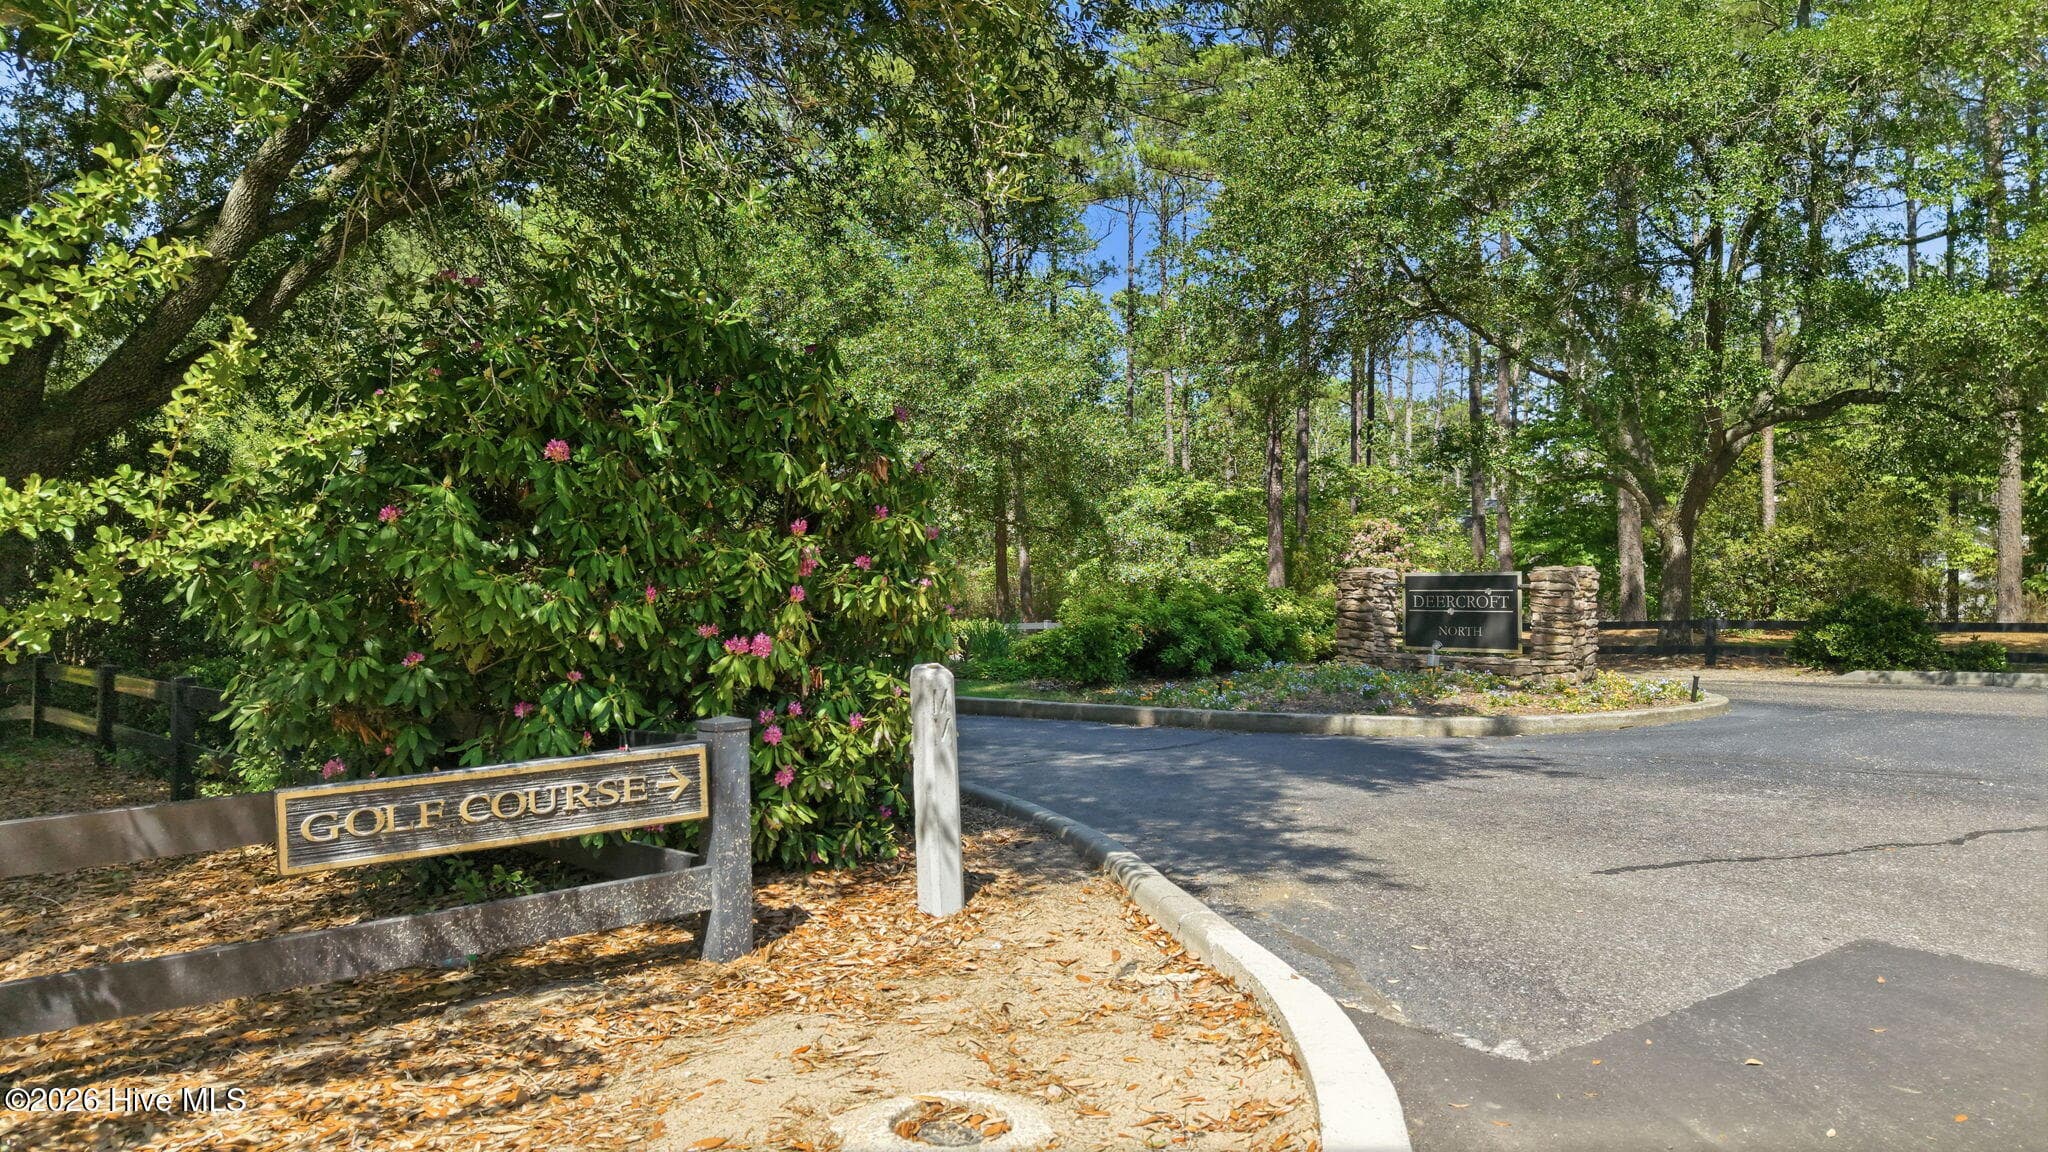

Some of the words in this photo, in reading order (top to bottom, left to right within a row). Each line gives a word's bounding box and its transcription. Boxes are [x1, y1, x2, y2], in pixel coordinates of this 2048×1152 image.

[1413, 595, 1510, 609] DEERCROFT
[1438, 626, 1483, 637] NORTH
[299, 799, 445, 843] GOLF
[458, 775, 649, 825] COURSE
